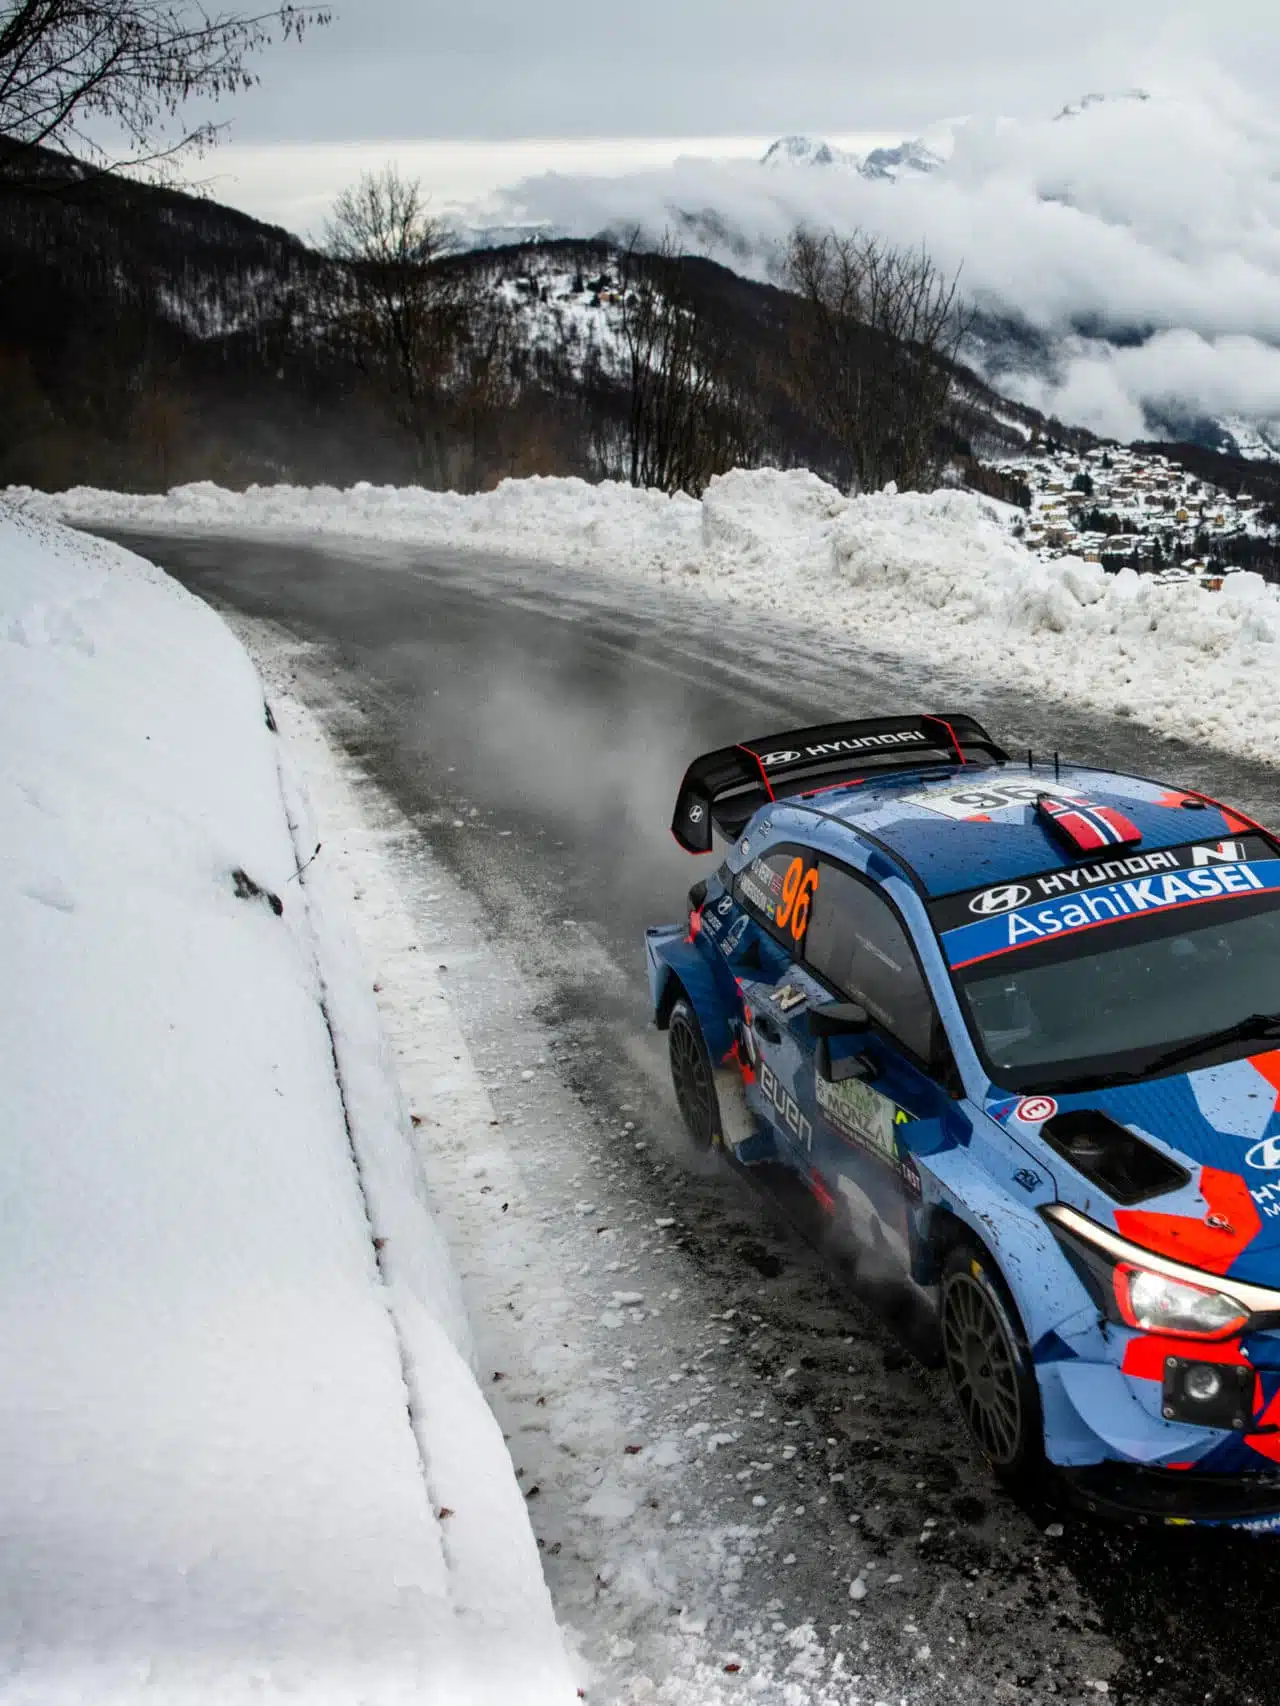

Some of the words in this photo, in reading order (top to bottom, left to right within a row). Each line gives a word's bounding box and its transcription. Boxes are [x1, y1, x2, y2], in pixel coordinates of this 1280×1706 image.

[805, 730, 927, 756] HYUNDAI
[950, 785, 1055, 810] 96
[1036, 851, 1181, 894] HYUNDAI
[775, 856, 819, 941] 96
[1008, 864, 1265, 945] AsahiKASEI
[1026, 1102, 1047, 1117] E
